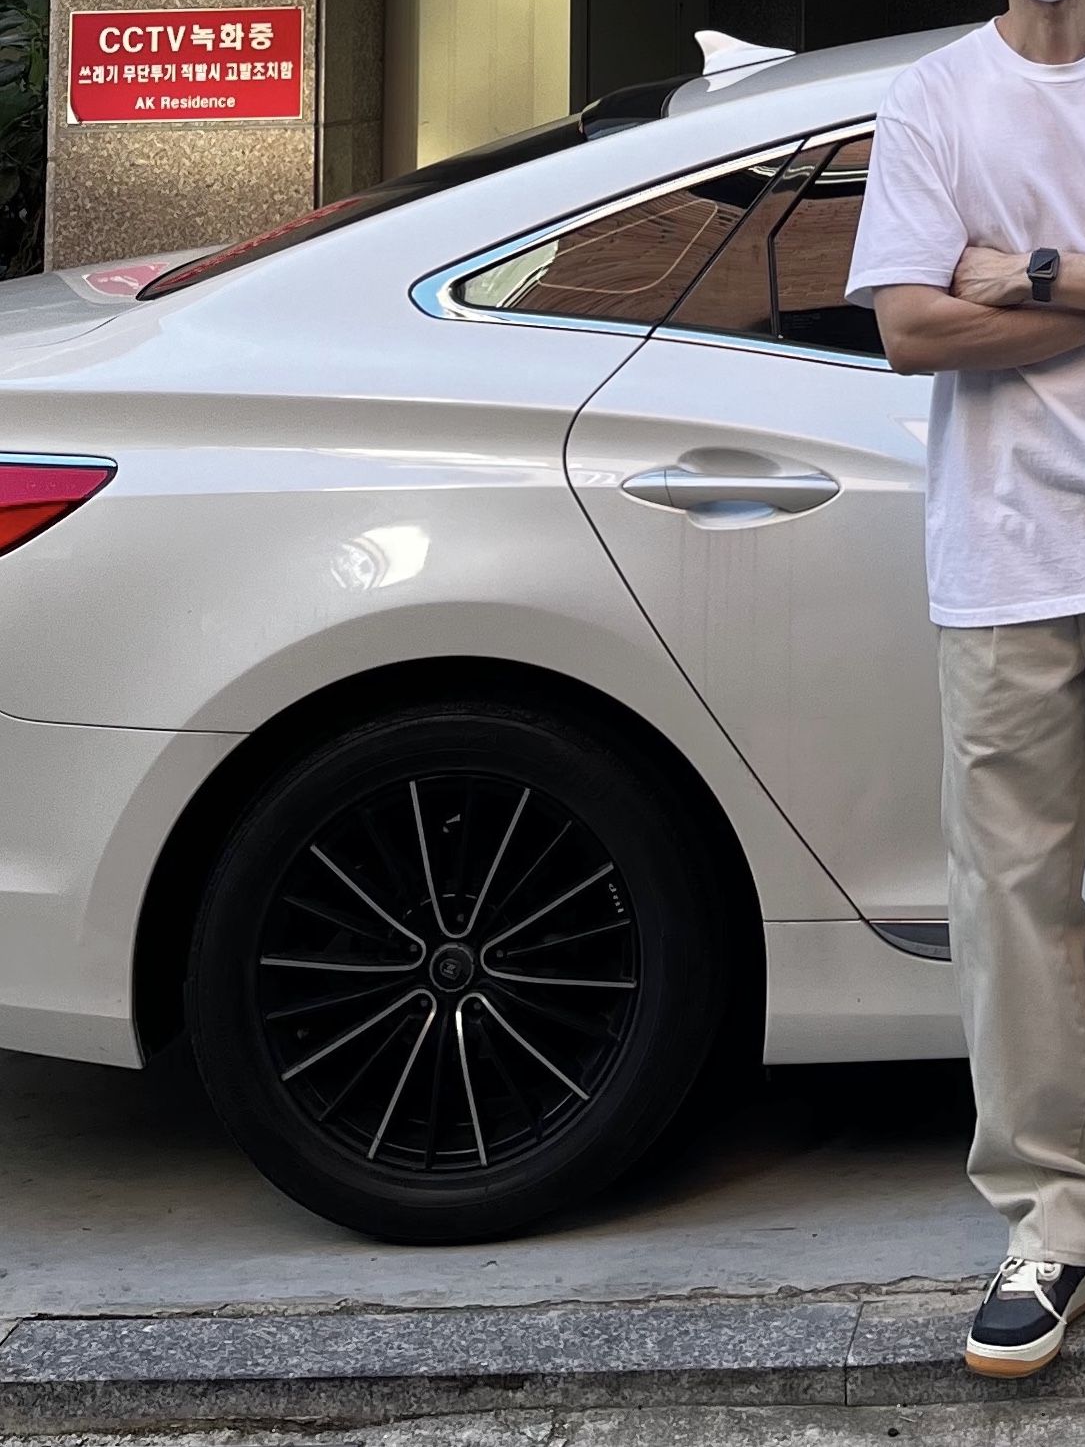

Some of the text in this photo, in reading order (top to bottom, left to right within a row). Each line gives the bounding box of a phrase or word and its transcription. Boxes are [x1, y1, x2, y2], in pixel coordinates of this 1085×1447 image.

[78, 61, 293, 84] 쓰레기 무단투기 적발시 고발조치함
[135, 96, 236, 110] AK Residence
